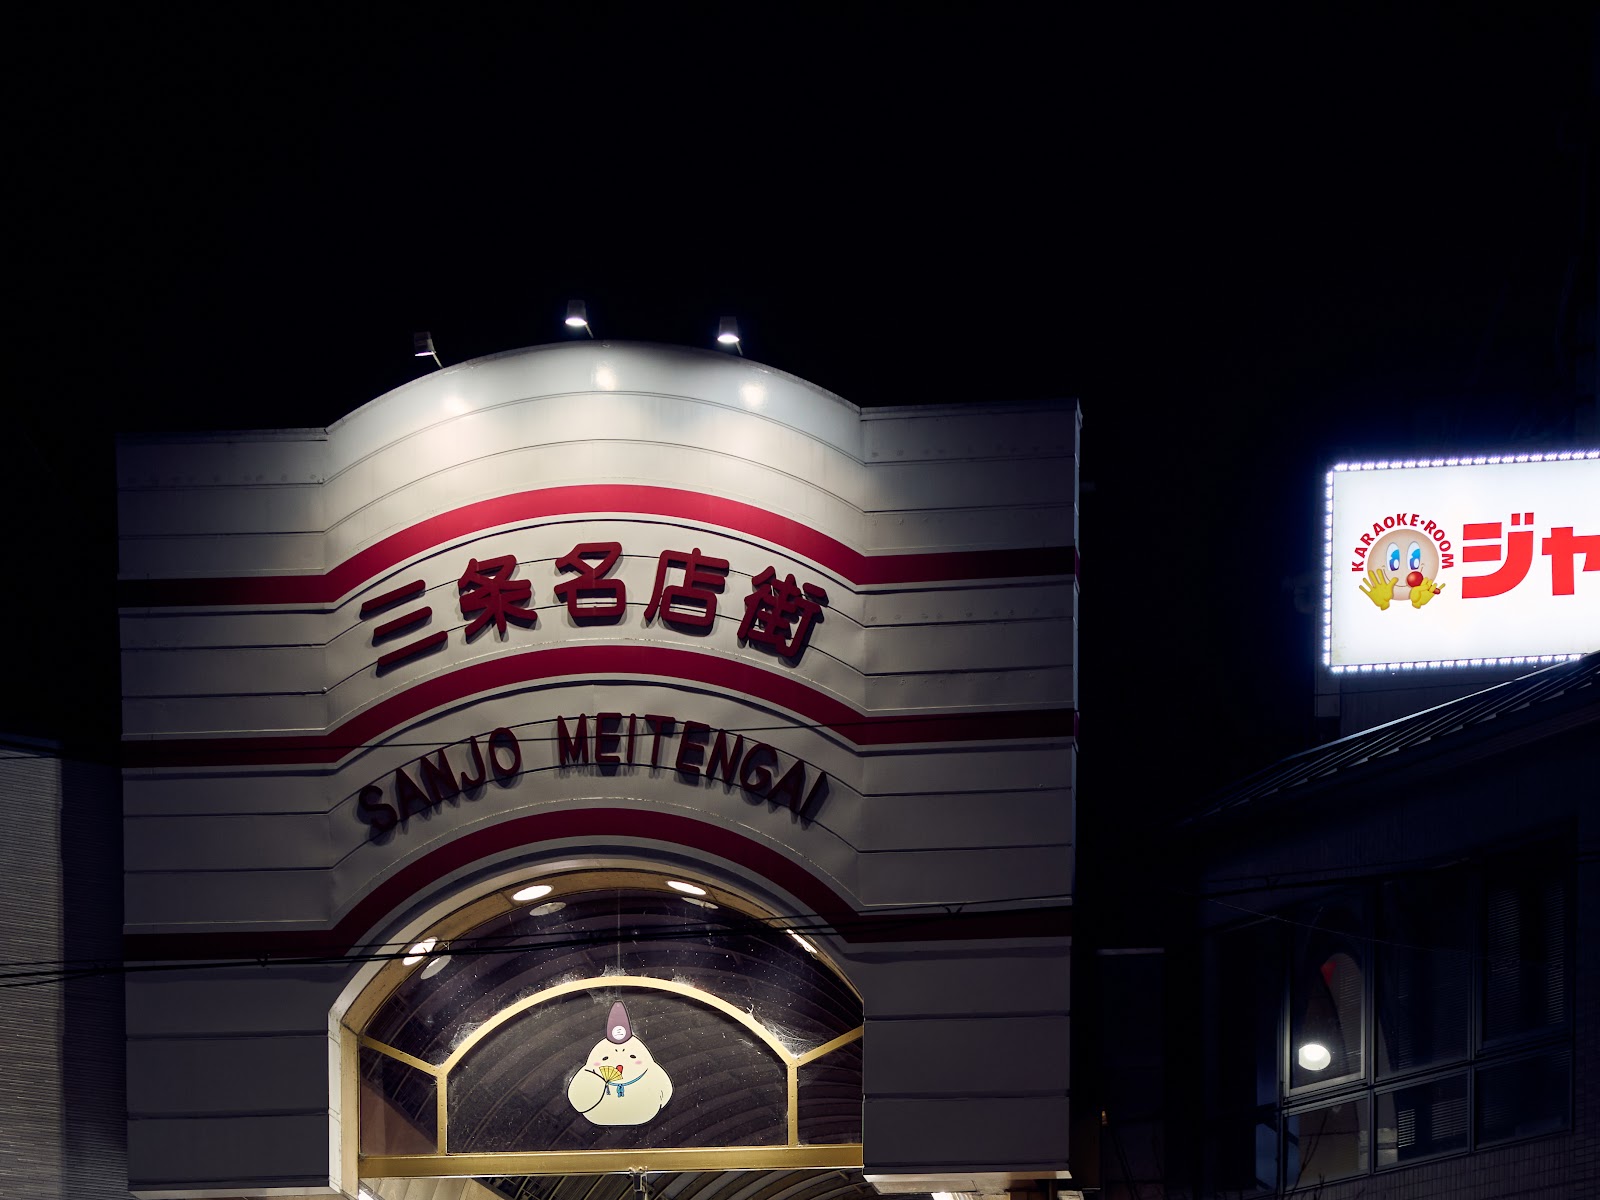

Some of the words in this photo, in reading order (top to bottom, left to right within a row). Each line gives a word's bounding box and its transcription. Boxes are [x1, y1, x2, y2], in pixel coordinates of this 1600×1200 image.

[361, 541, 830, 664] 三条名店街
[358, 726, 522, 833] SANJO
[556, 711, 831, 816] MEITENGAI
